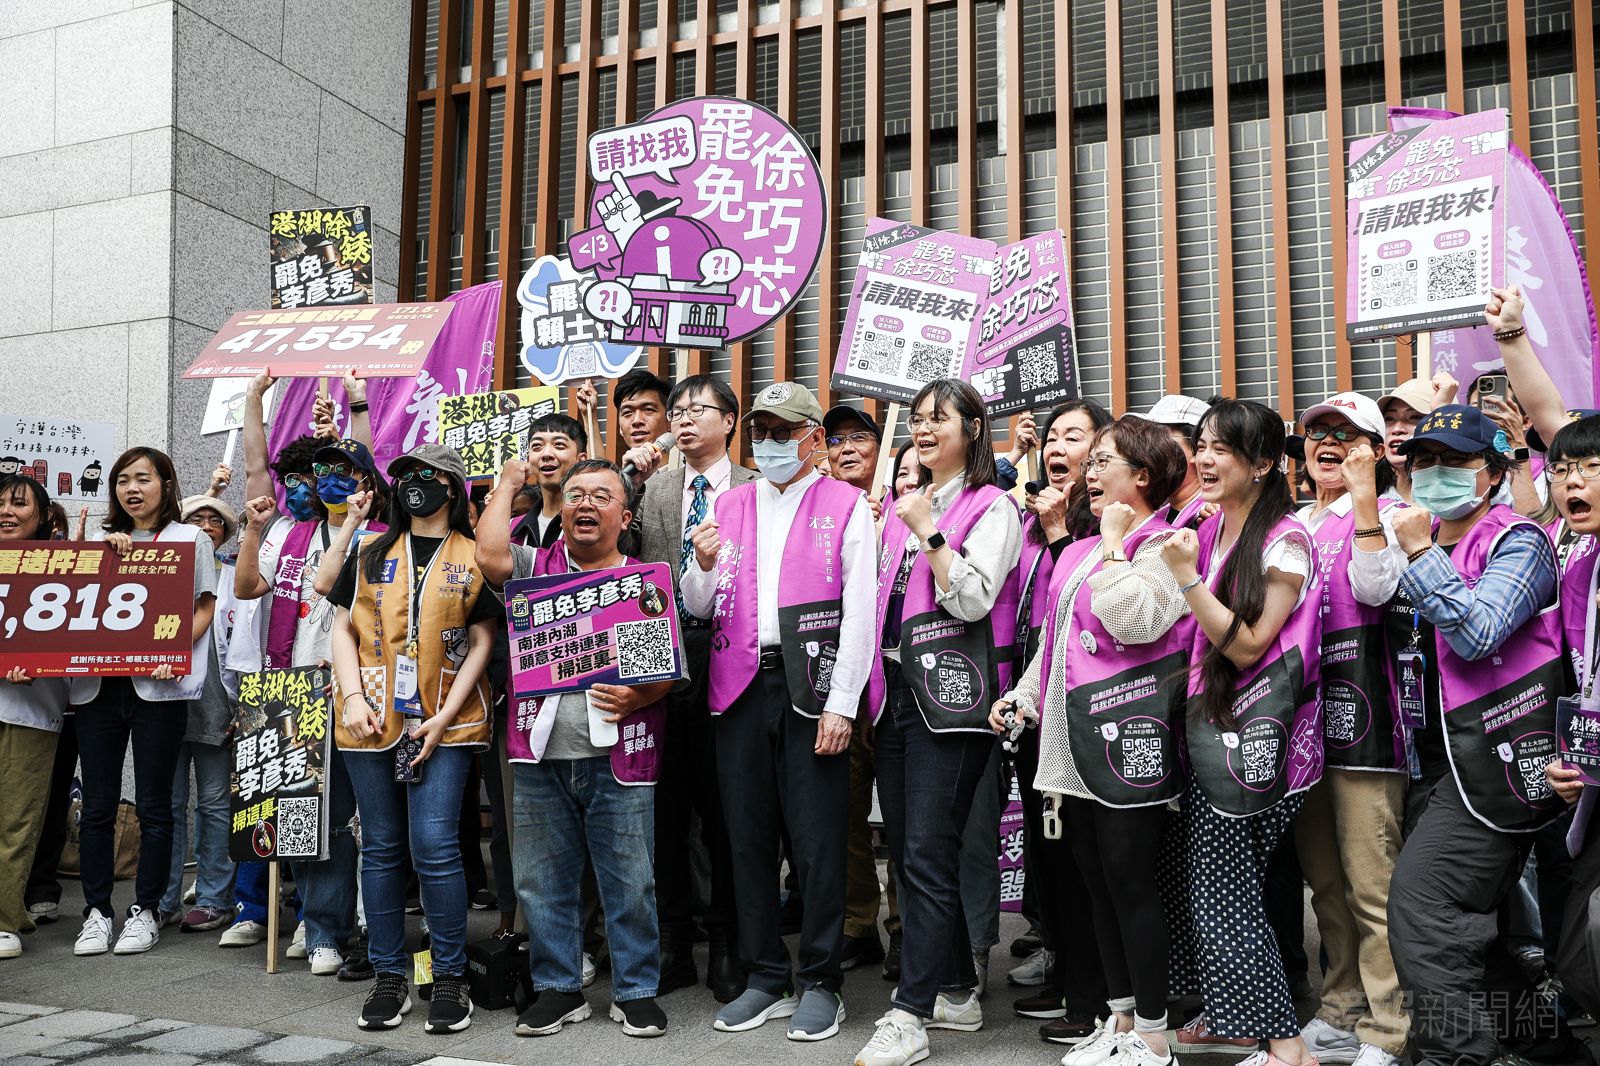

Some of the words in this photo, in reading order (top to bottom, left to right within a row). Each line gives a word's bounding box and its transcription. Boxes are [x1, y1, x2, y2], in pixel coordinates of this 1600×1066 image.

[595, 126, 690, 172] 請找我
[690, 102, 753, 223] 罷免
[1404, 135, 1456, 167] 罷免
[1386, 157, 1464, 194] 徐巧芯
[736, 133, 807, 316] 徐巧芯
[912, 240, 957, 265] 罷免
[274, 254, 323, 289] 罷免
[892, 256, 959, 286] 徐巧芯
[1385, 280, 1402, 288] LINE
[599, 289, 618, 312] ?!
[216, 323, 409, 356] 47,554
[874, 349, 889, 358] LINE
[1326, 399, 1357, 410] FILA
[117, 565, 178, 575] 達標安全門檻
[280, 558, 304, 579] 罷
[442, 562, 467, 575] 文山
[532, 573, 644, 628] 罷免李彥秀
[517, 621, 578, 653] 南港內湖
[519, 631, 610, 671] 願意支持連署
[517, 699, 537, 716] 罷免
[623, 721, 647, 740] 國會
[236, 727, 280, 773] 罷免
[238, 746, 307, 802] 李彥秀
